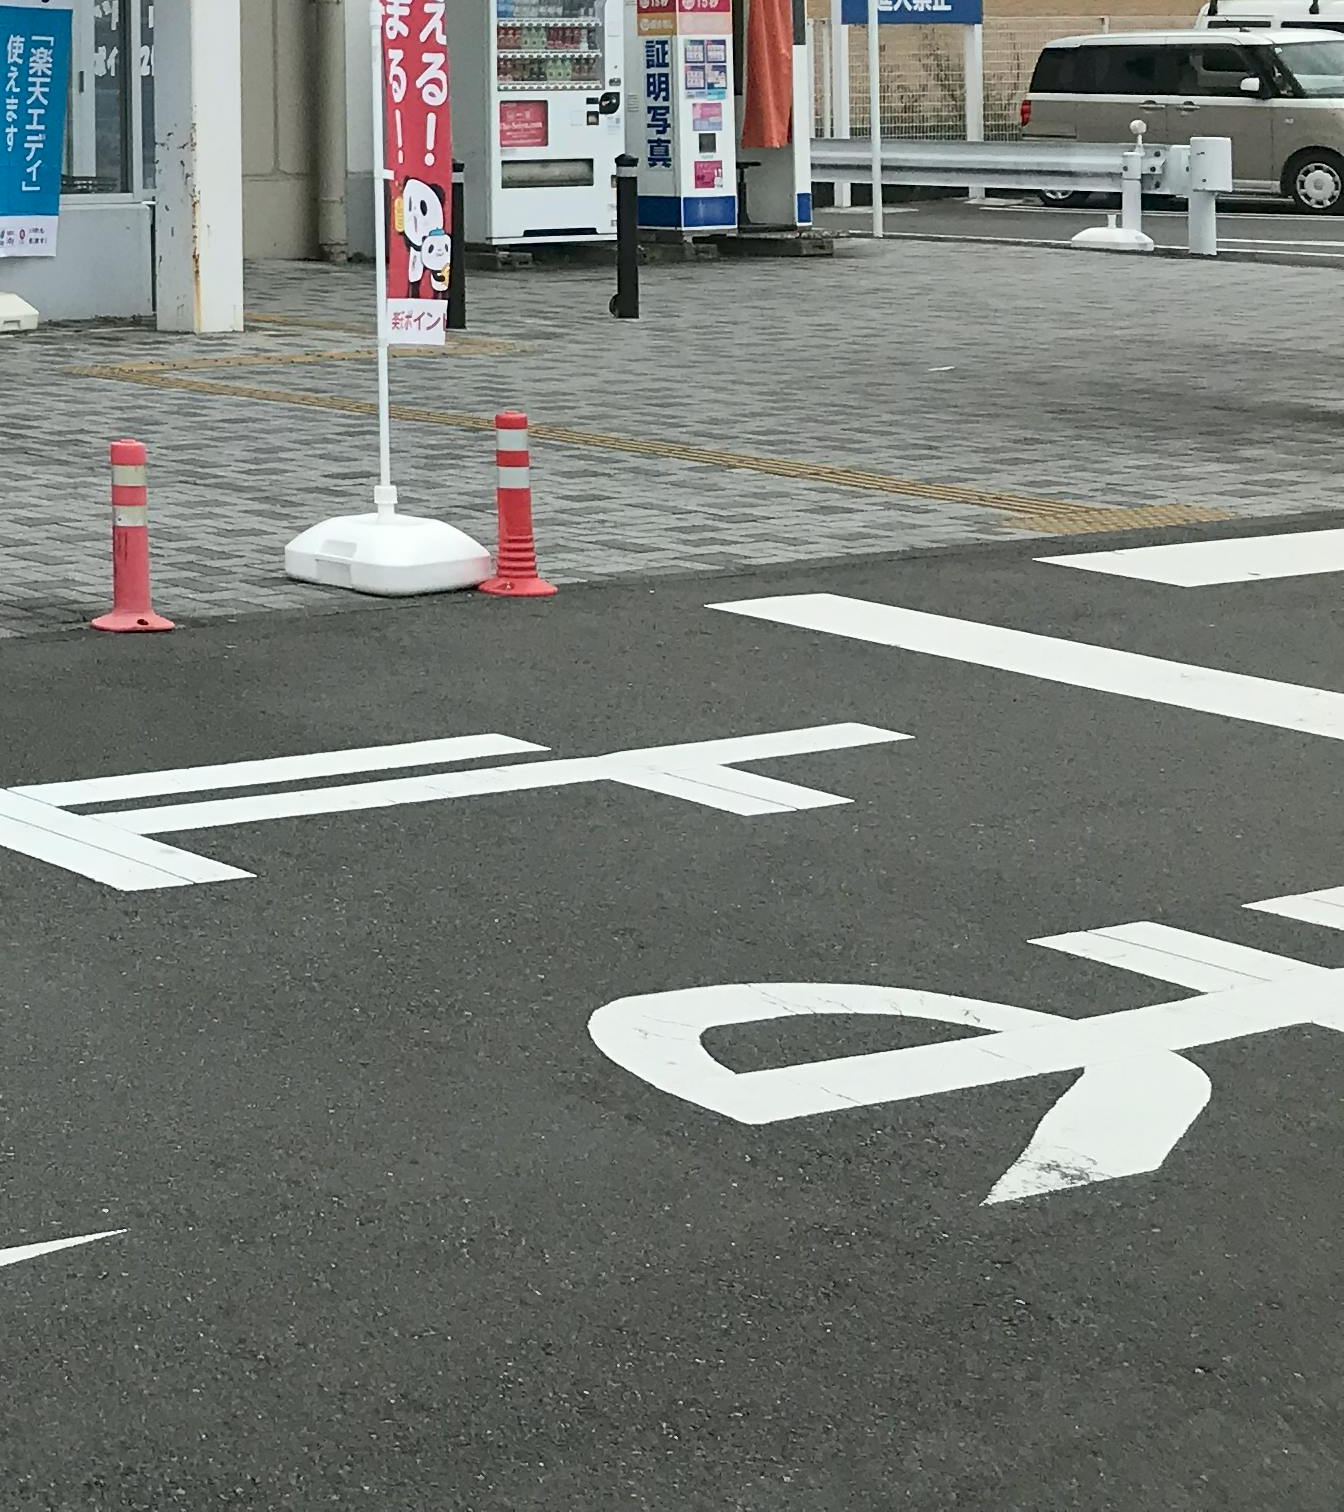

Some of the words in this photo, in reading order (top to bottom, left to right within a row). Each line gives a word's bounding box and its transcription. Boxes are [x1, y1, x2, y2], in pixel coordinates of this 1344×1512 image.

[4, 33, 26, 153] 使えます
[645, 39, 673, 169] 証明写真
